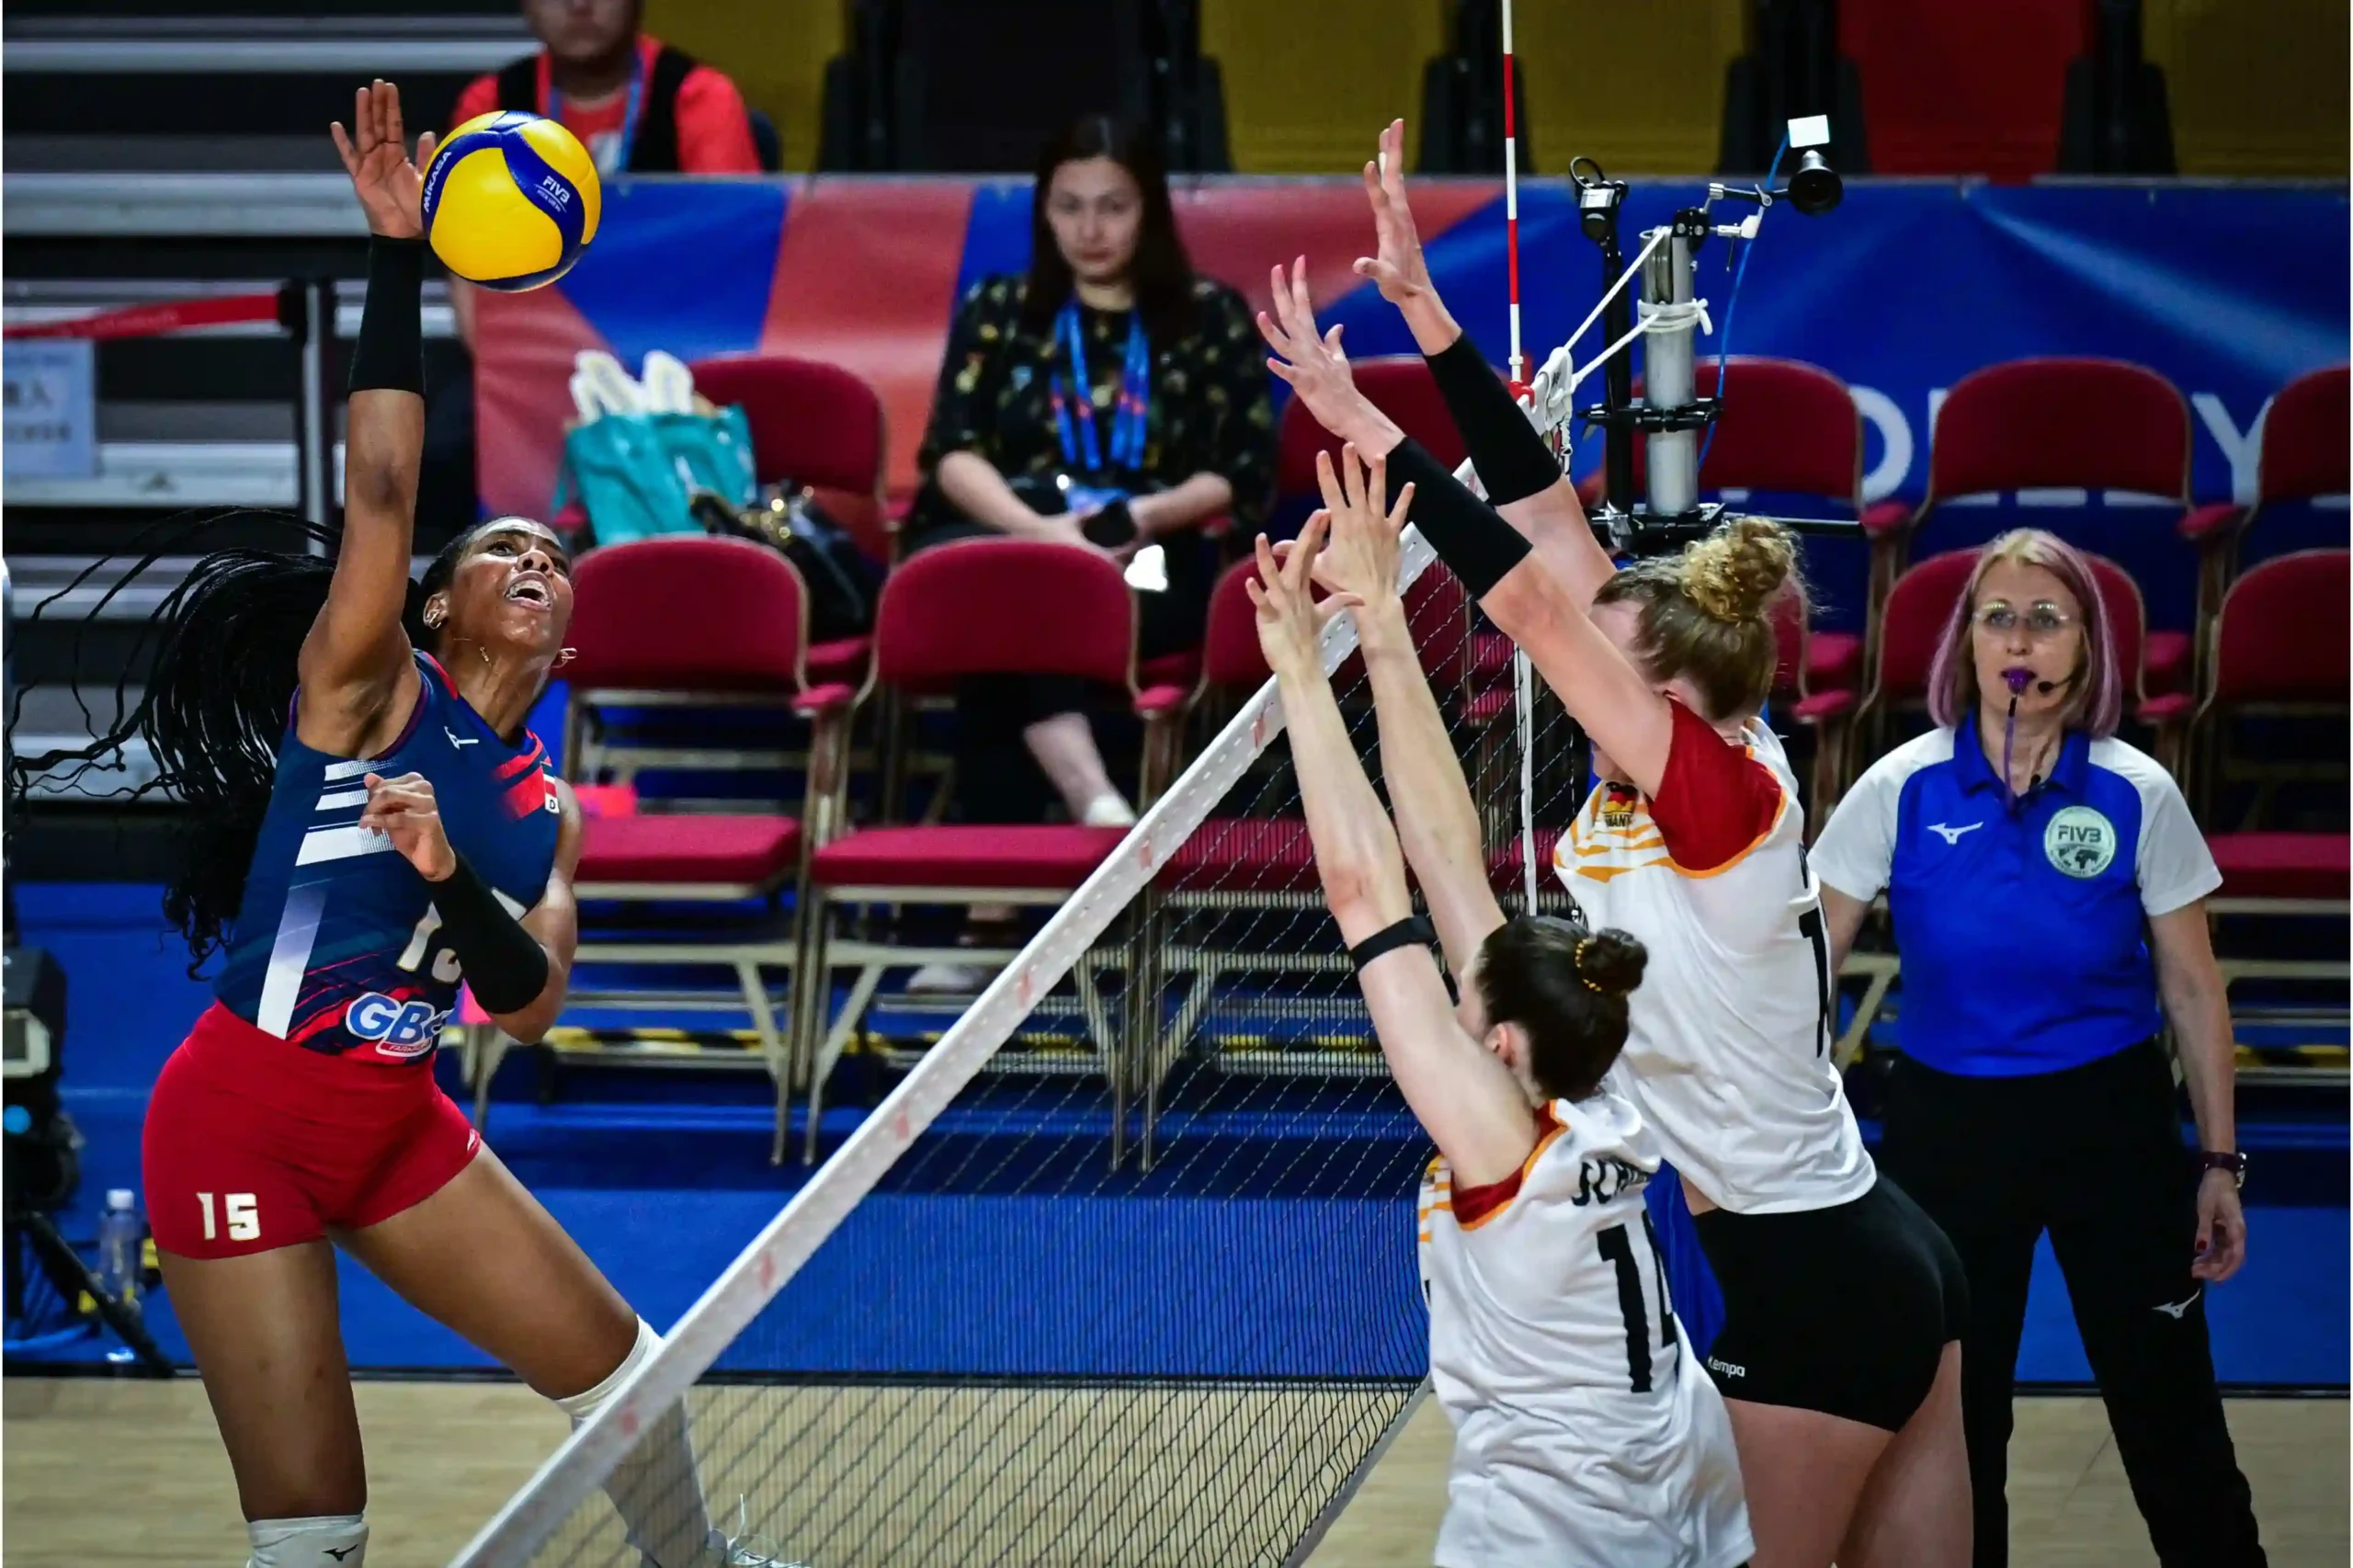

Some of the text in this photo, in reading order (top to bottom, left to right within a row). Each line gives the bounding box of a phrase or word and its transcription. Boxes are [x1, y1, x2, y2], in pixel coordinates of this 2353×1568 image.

[542, 176, 570, 204] FIVB
[2058, 824, 2102, 843] FIVB
[196, 1191, 261, 1241] 15
